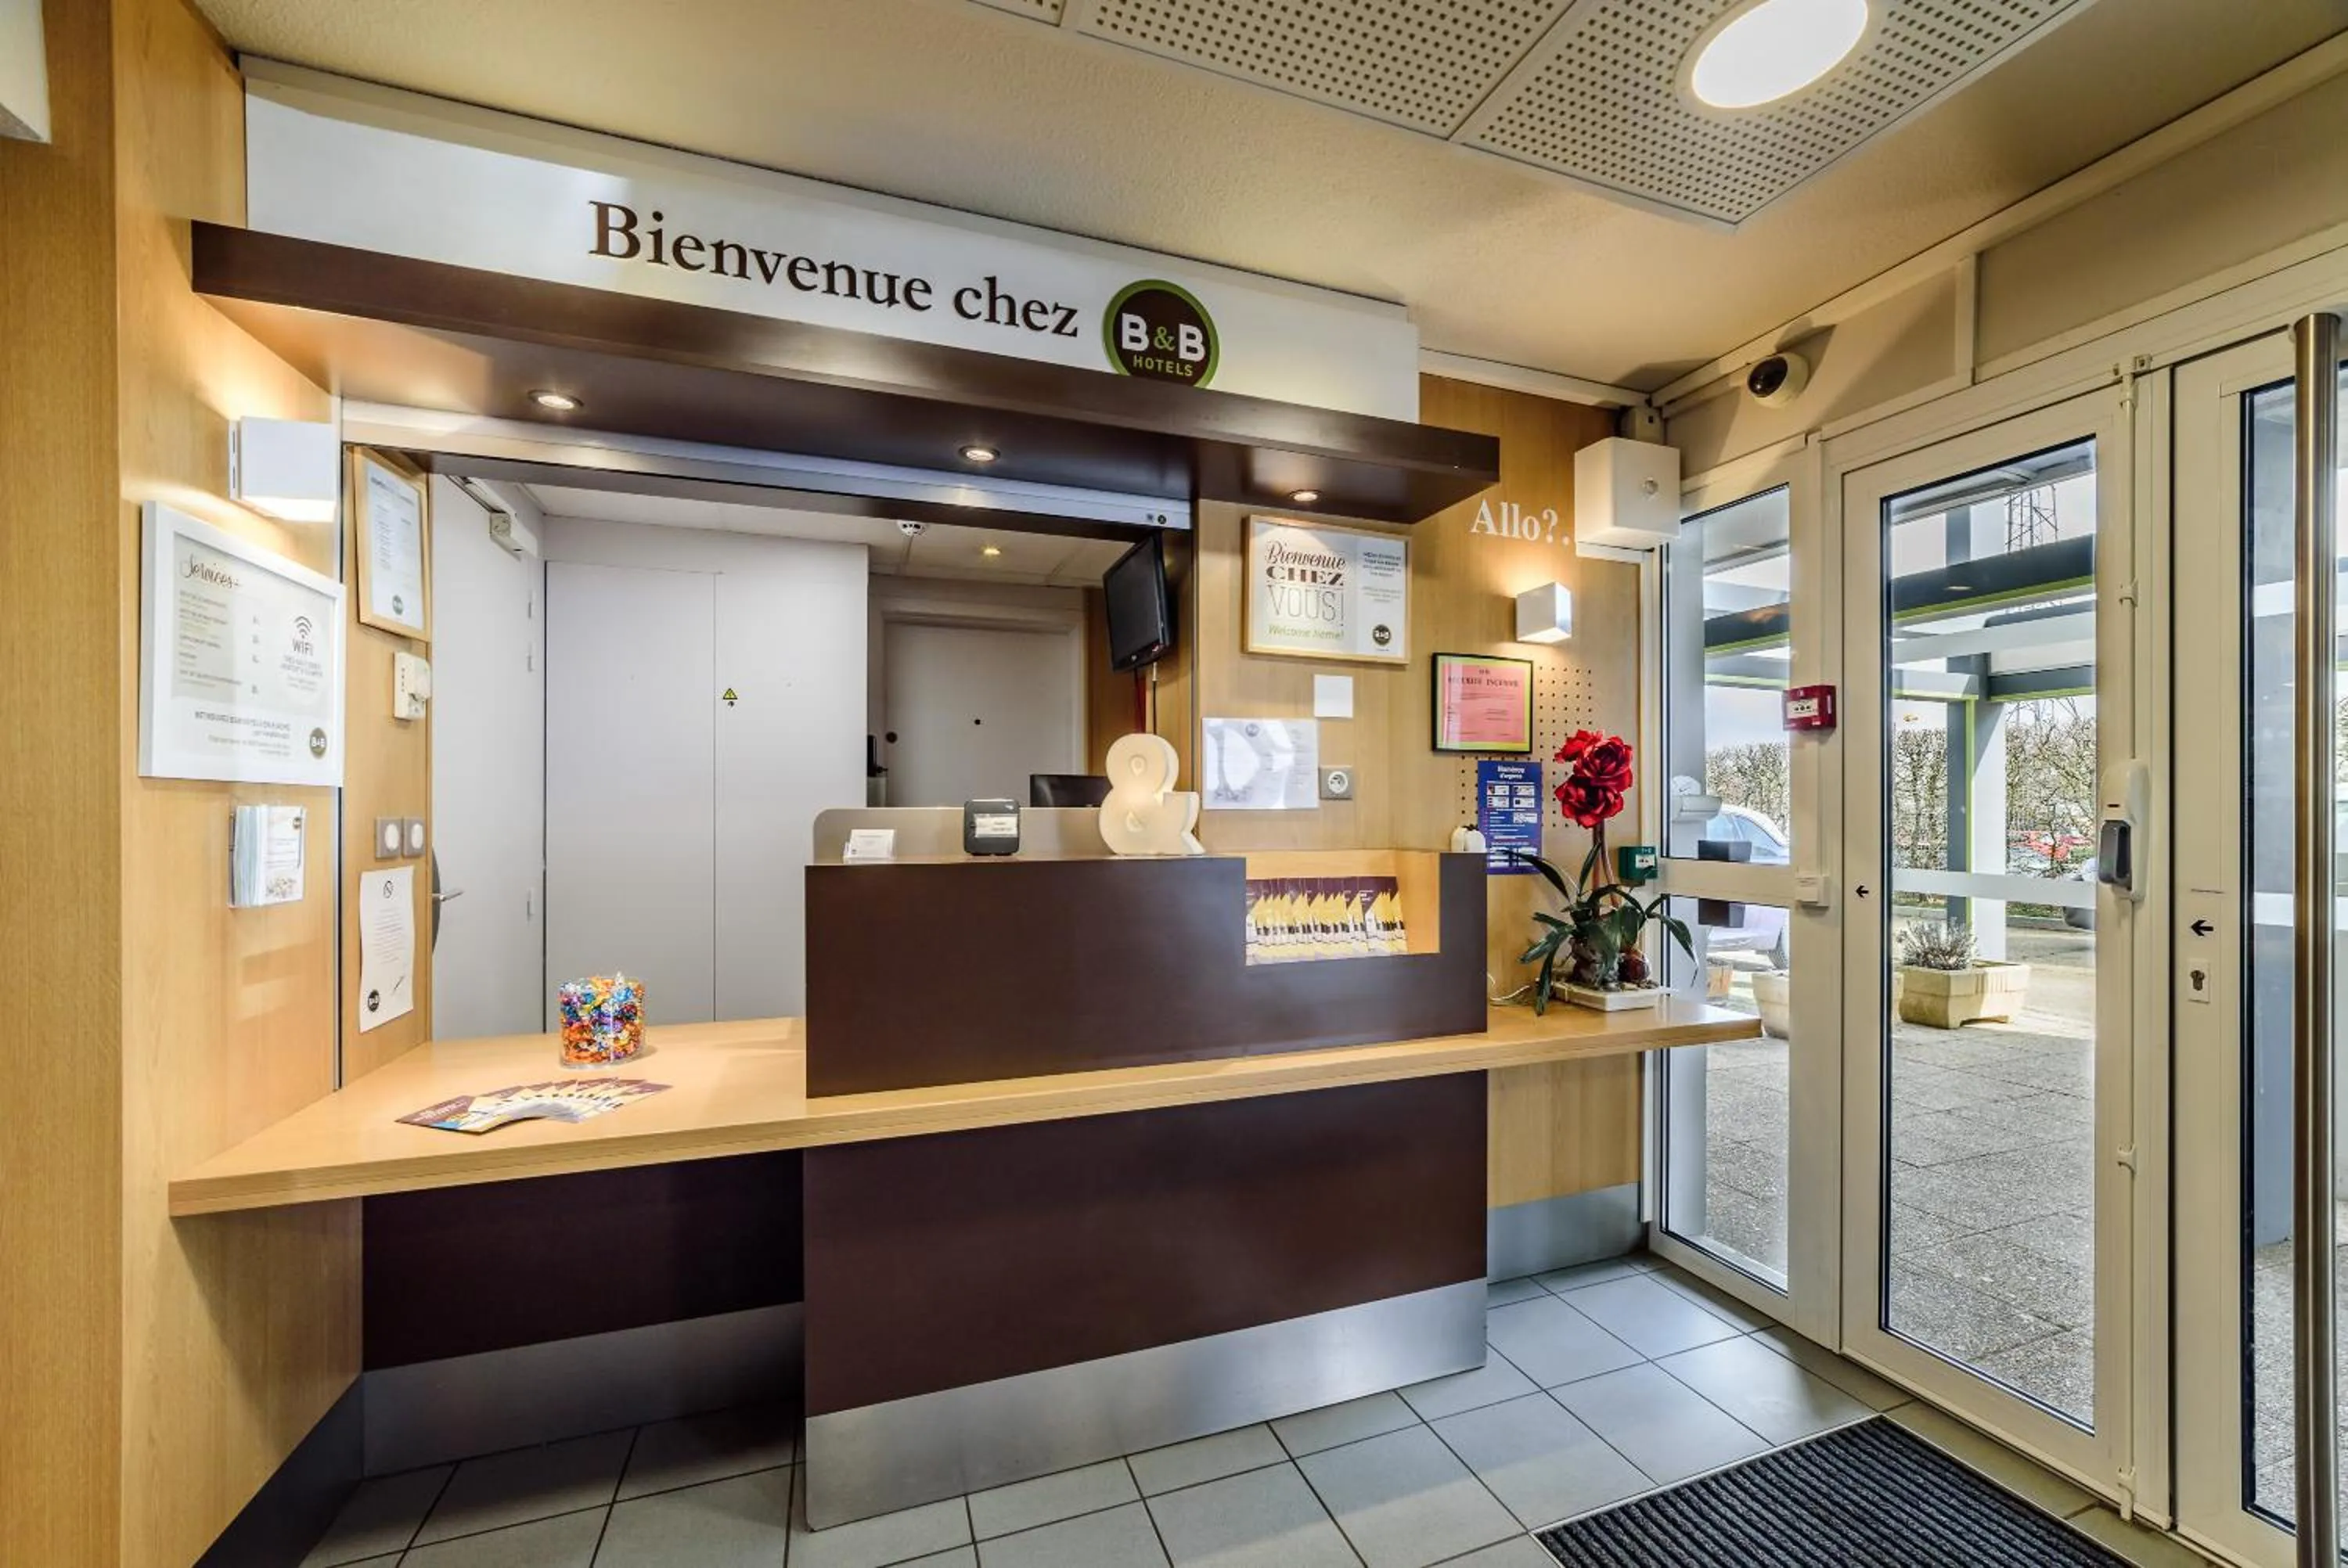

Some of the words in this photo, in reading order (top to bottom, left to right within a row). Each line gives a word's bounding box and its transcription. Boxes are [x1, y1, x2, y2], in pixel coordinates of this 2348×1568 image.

[588, 200, 934, 312] Bienvenue
[953, 275, 1079, 338] chez
[1121, 313, 1206, 362] B&B
[1133, 354, 1194, 377] HOTELS
[1265, 540, 1346, 570] Bienvenue
[1266, 565, 1345, 587] CHEZ
